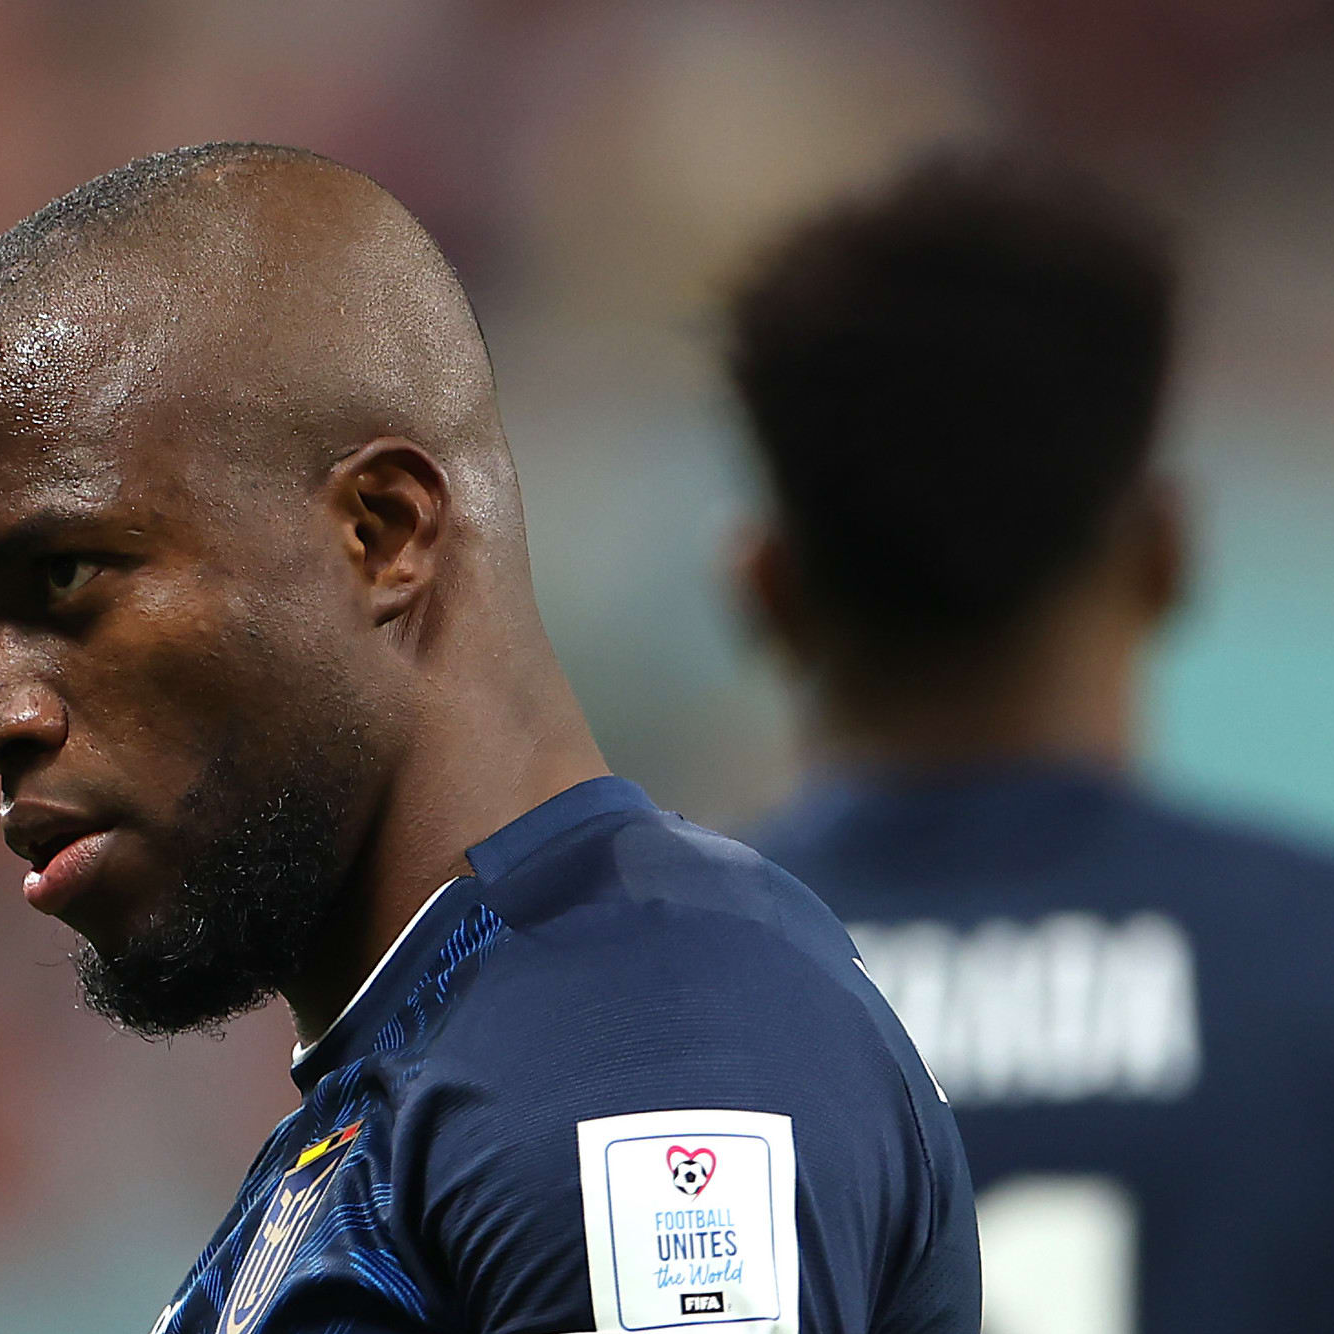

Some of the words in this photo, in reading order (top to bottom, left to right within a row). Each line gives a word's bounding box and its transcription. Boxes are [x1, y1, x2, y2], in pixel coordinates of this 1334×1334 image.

[655, 1208, 735, 1231] FOOTBALL
[657, 1230, 737, 1261] UNITES
[653, 1263, 686, 1289] the
[689, 1259, 744, 1286] World
[684, 1295, 722, 1312] FIFA
